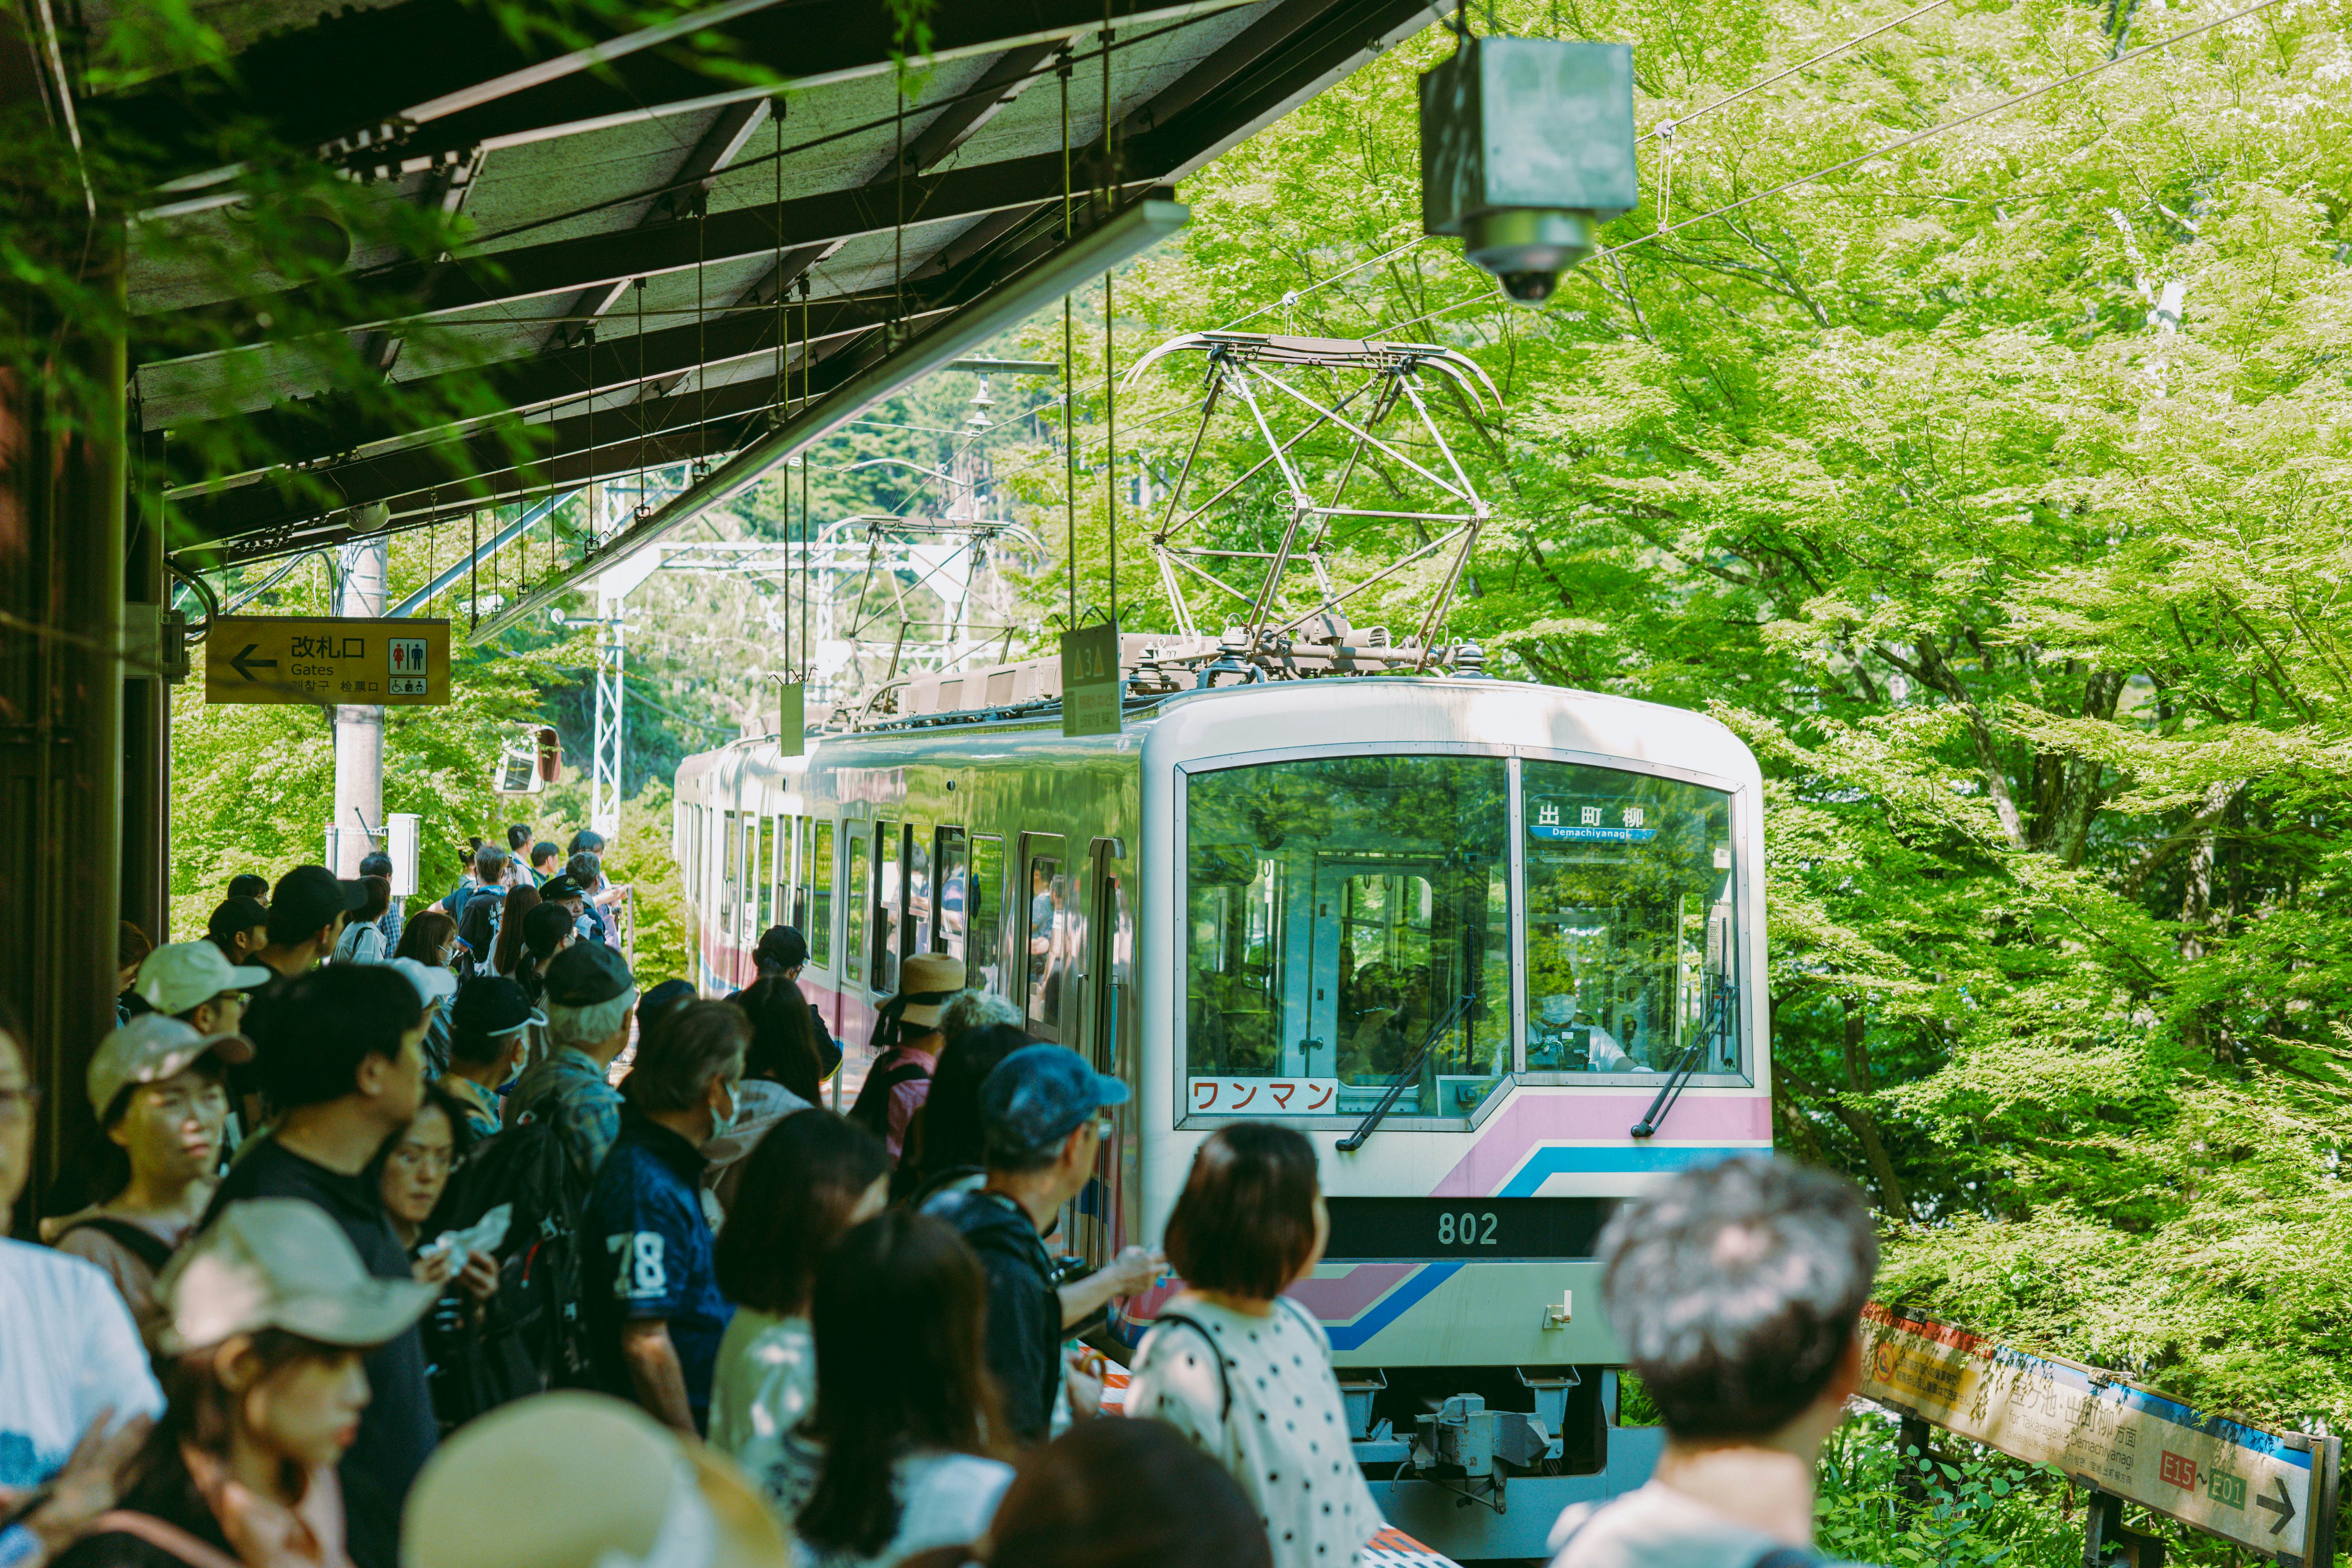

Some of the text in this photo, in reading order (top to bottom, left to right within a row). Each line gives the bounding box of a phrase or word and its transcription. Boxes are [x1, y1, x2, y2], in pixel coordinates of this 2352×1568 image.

[291, 636, 364, 659] 改札口
[291, 663, 334, 676] Gates
[292, 680, 378, 693] 개찰구 检票口
[1539, 804, 1644, 828] 出町柳
[1552, 828, 1628, 839] Demachiyanagi
[1194, 1082, 1333, 1110] ワンマン
[1438, 1212, 1497, 1245] 802
[606, 1230, 667, 1293] 78
[2008, 1410, 2020, 1425] for
[2071, 1432, 2134, 1470] Demachiyanagi
[2074, 1455, 2086, 1468] 방면
[2163, 1455, 2192, 1485] E15
[2212, 1473, 2241, 1504] E01
